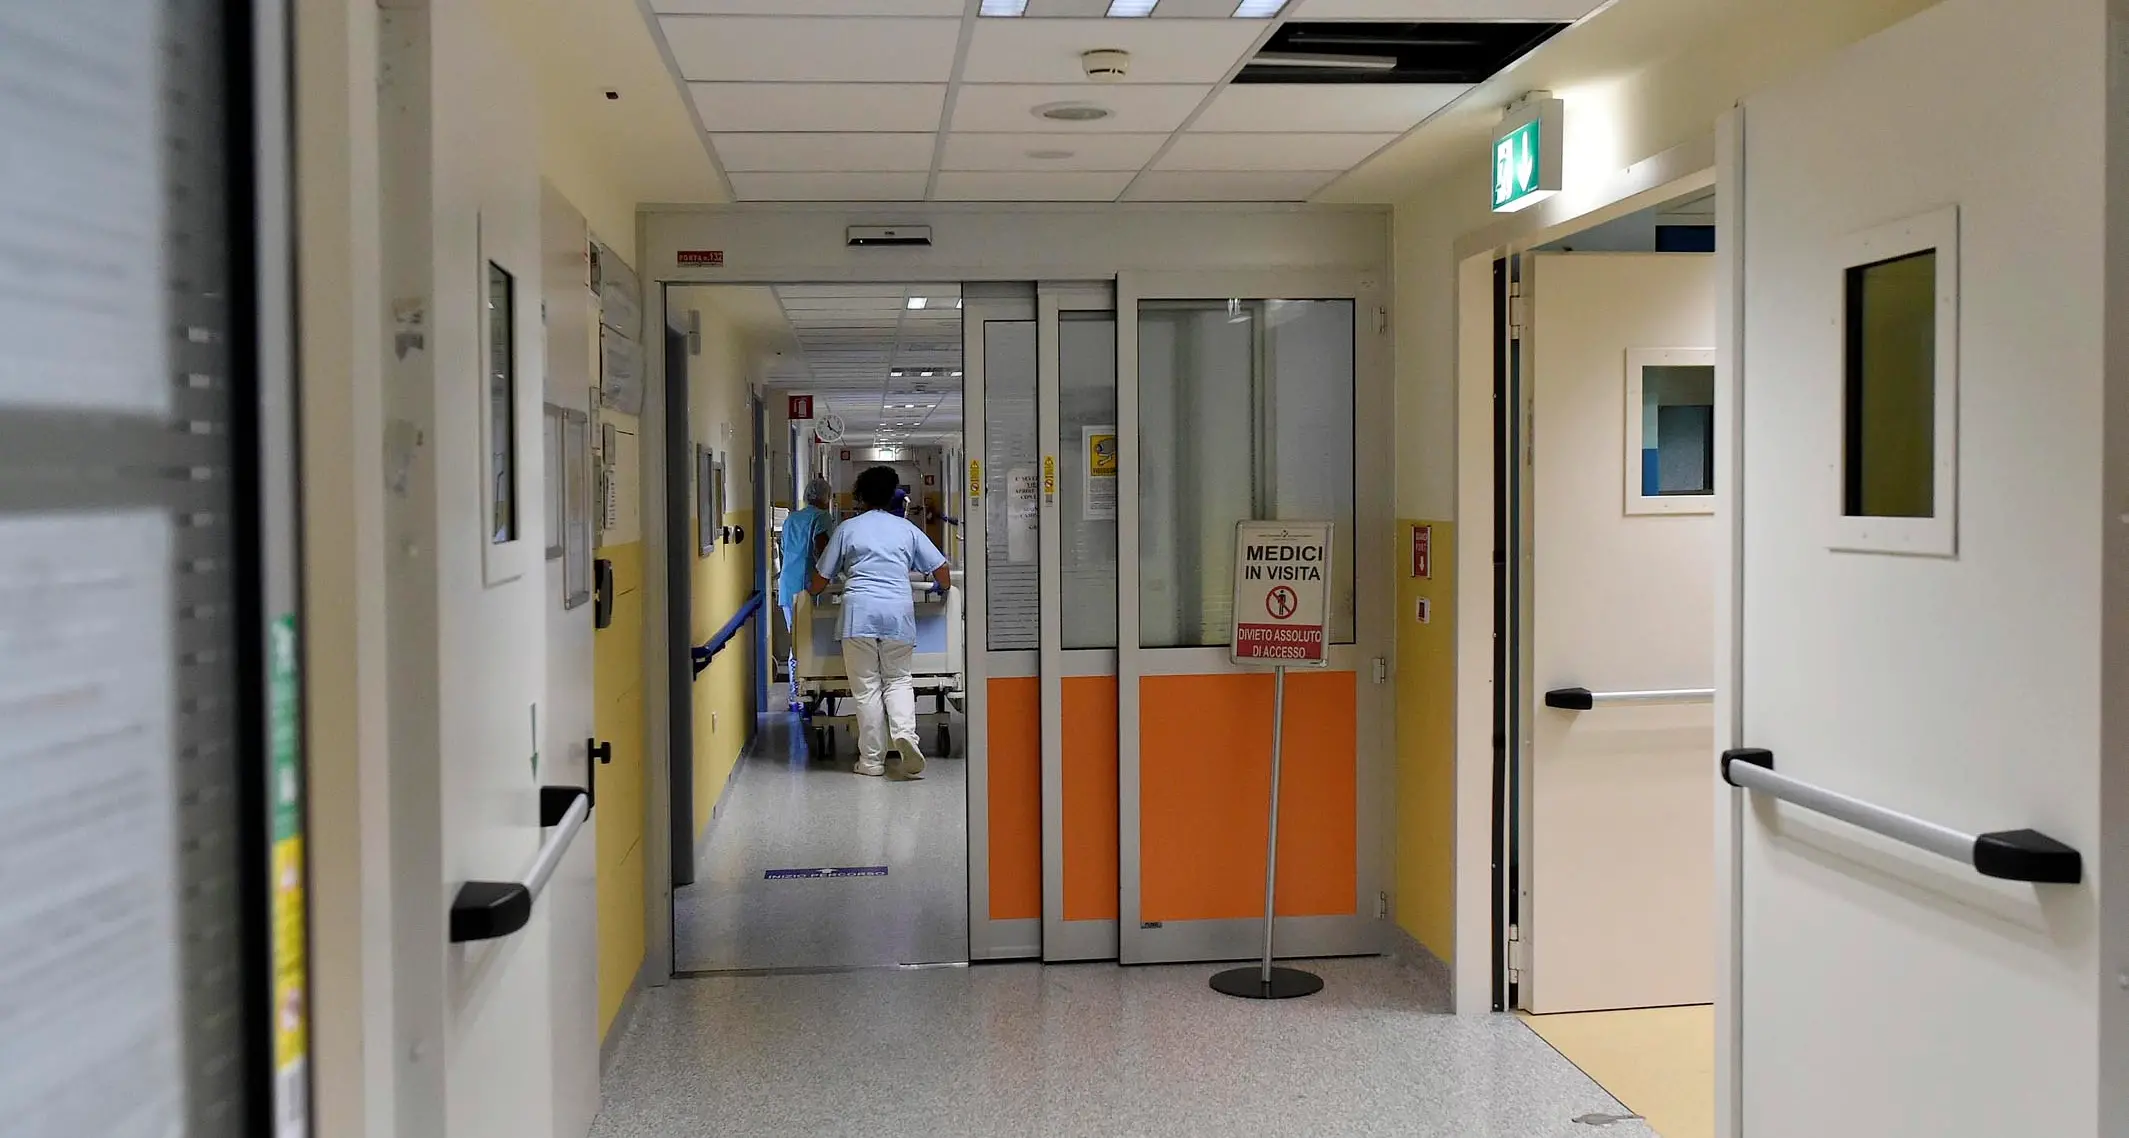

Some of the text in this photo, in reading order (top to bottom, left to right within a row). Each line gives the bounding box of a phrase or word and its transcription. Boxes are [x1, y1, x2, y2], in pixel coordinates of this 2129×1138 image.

[1246, 545, 1323, 562] MEDICI
[1245, 565, 1321, 581] IN VISITA
[1238, 628, 1322, 643] DIVIETO ASSOLUTO
[1252, 645, 1306, 659] DI ACCESSO
[810, 870, 885, 878] PERCORSO
